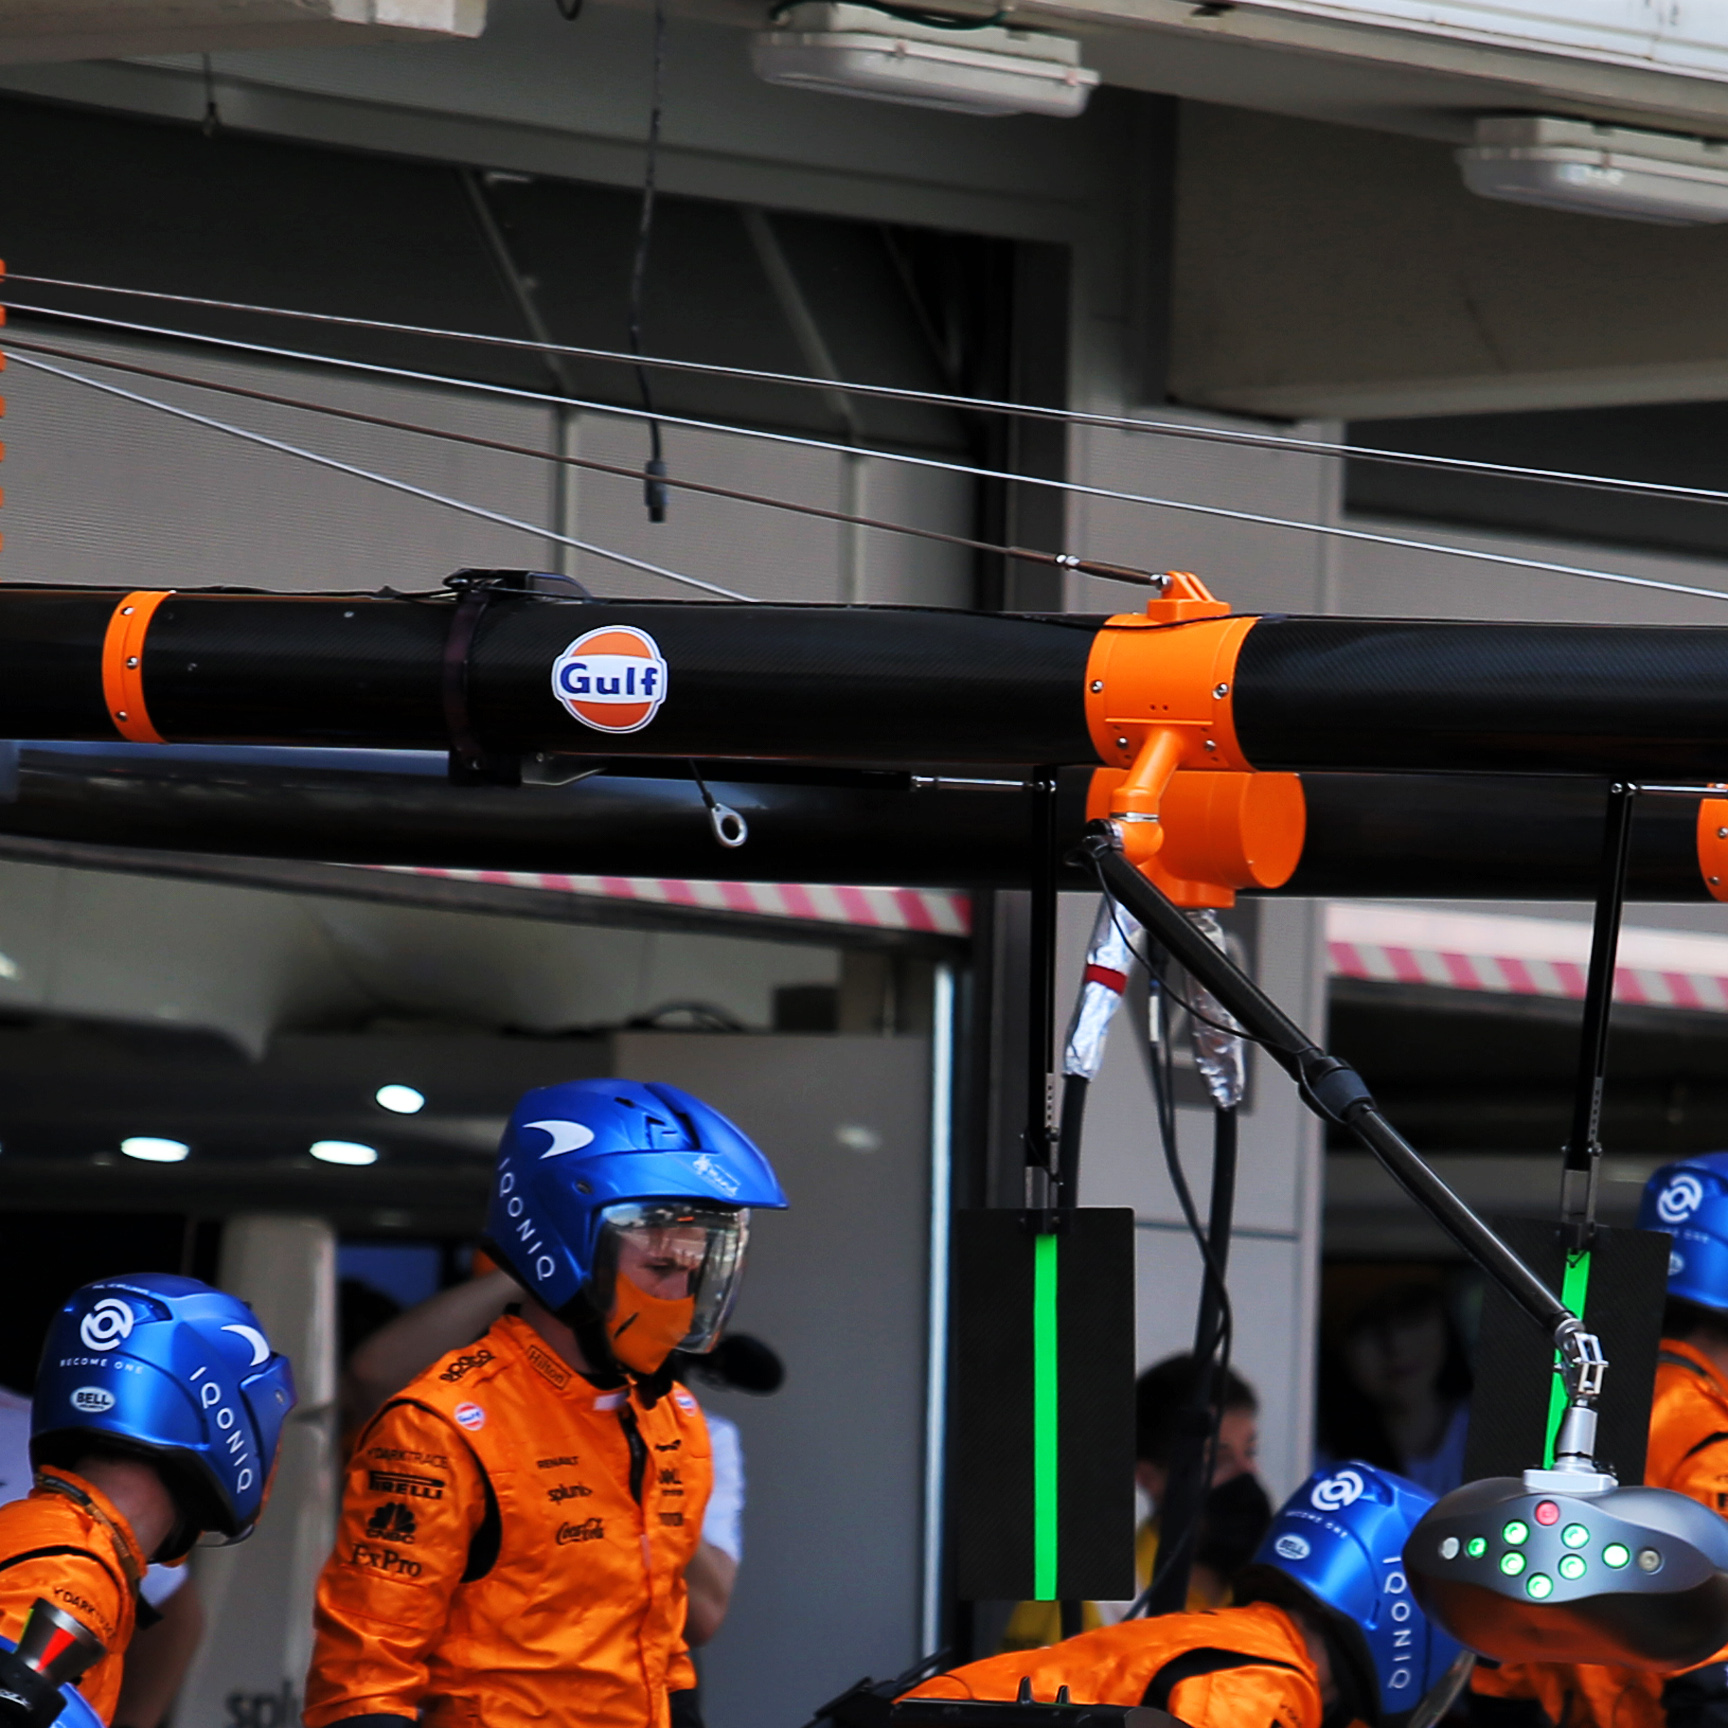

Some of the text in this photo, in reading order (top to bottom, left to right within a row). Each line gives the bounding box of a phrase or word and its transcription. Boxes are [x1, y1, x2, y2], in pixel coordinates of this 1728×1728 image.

[559, 661, 659, 698] Gulf
[498, 1157, 557, 1282] IQONIQ
[76, 1391, 110, 1406] BELL
[188, 1365, 255, 1494] IQONIQ
[368, 1470, 445, 1500] PIRELLI
[352, 1542, 423, 1578] FxPro
[1382, 1556, 1412, 1690] IQONIQ
